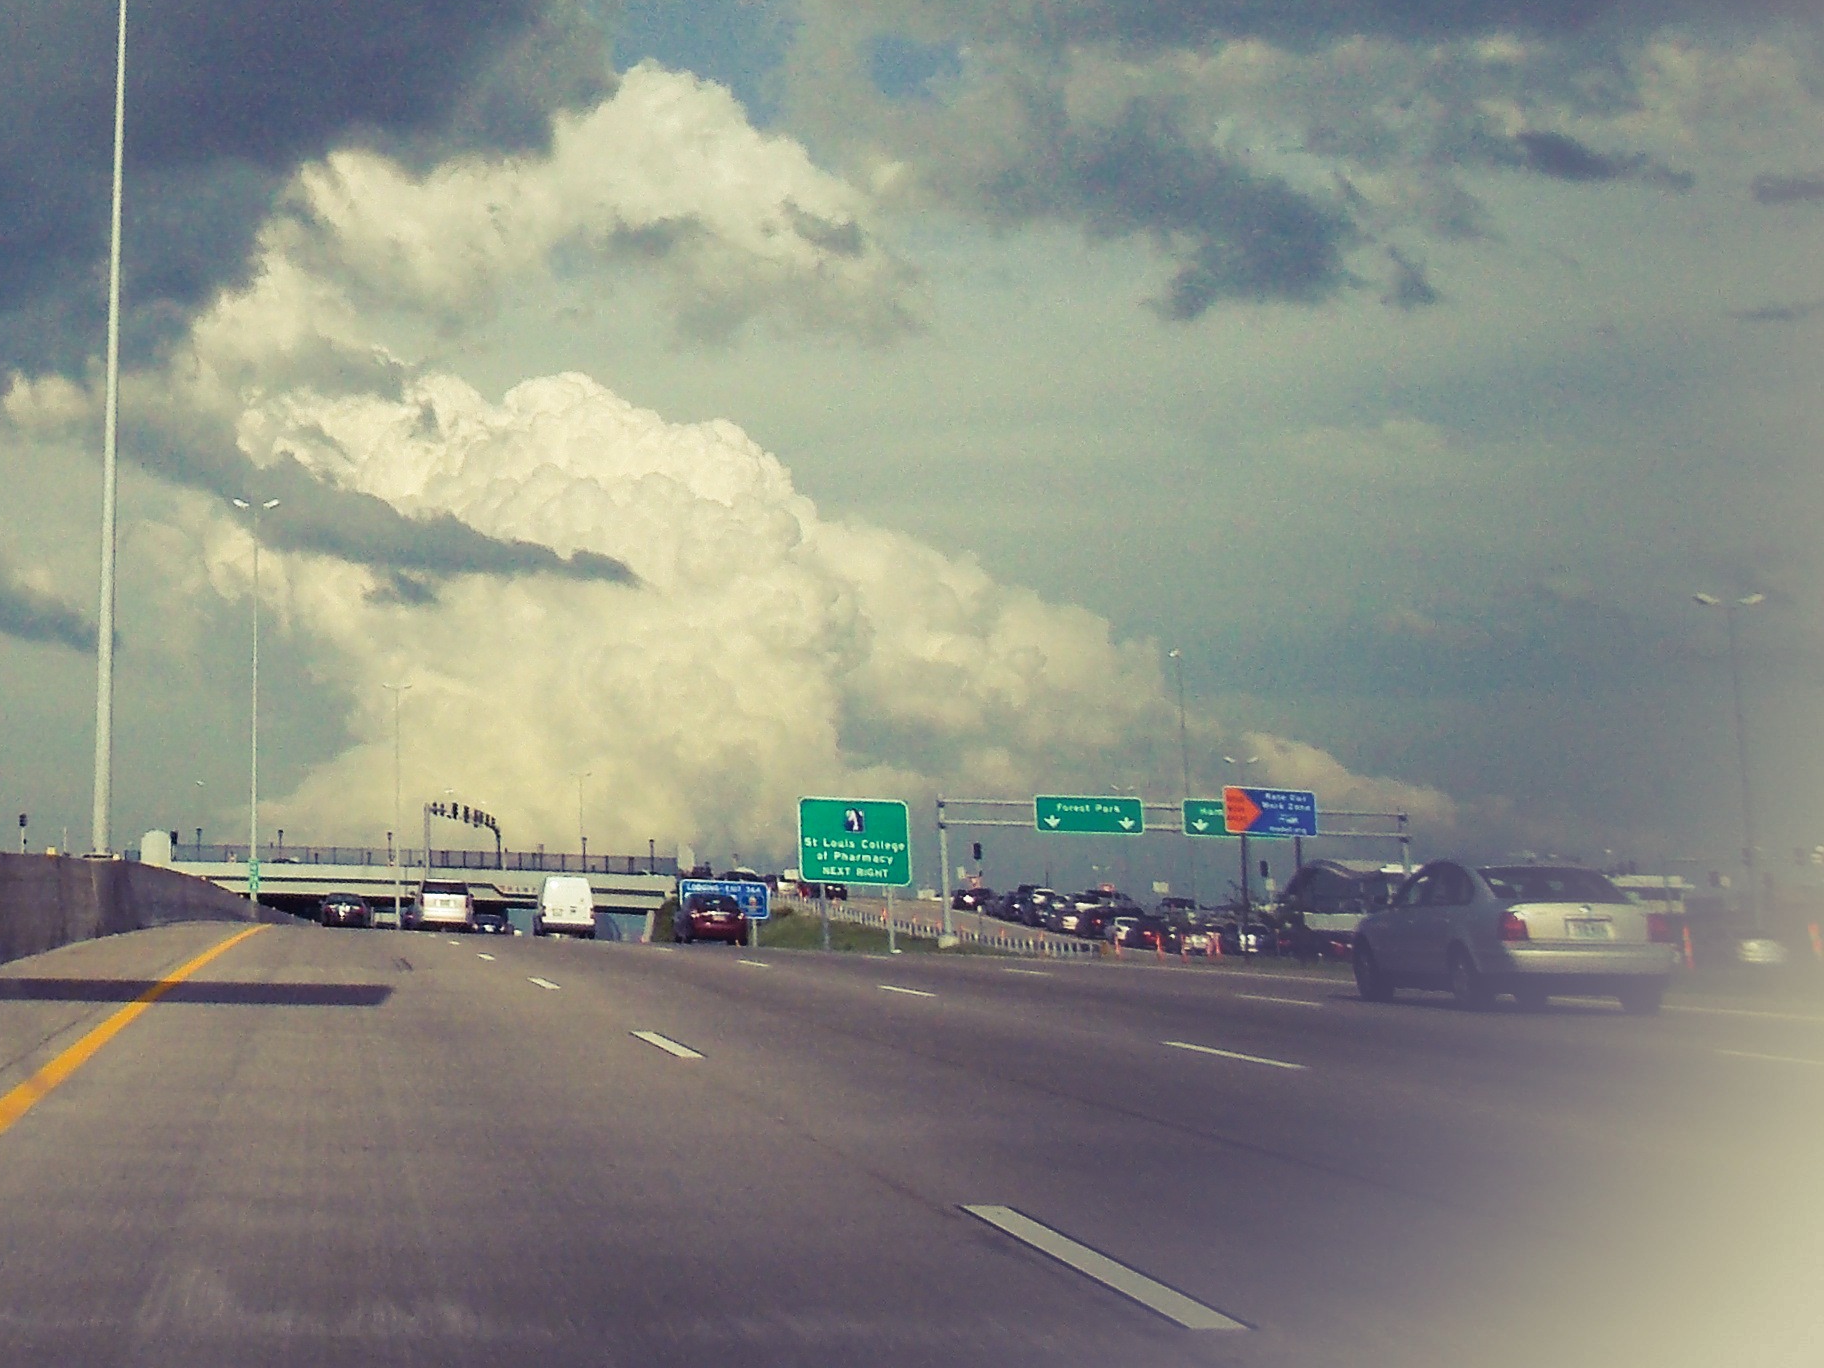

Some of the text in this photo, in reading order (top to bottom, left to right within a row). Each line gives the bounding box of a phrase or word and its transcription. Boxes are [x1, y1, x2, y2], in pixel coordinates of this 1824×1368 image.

[1057, 803, 1120, 813] Forest Park
[804, 837, 905, 853] St Louis College
[816, 851, 894, 865] of Pharmacy
[822, 867, 889, 878] NEXT RIGHT
